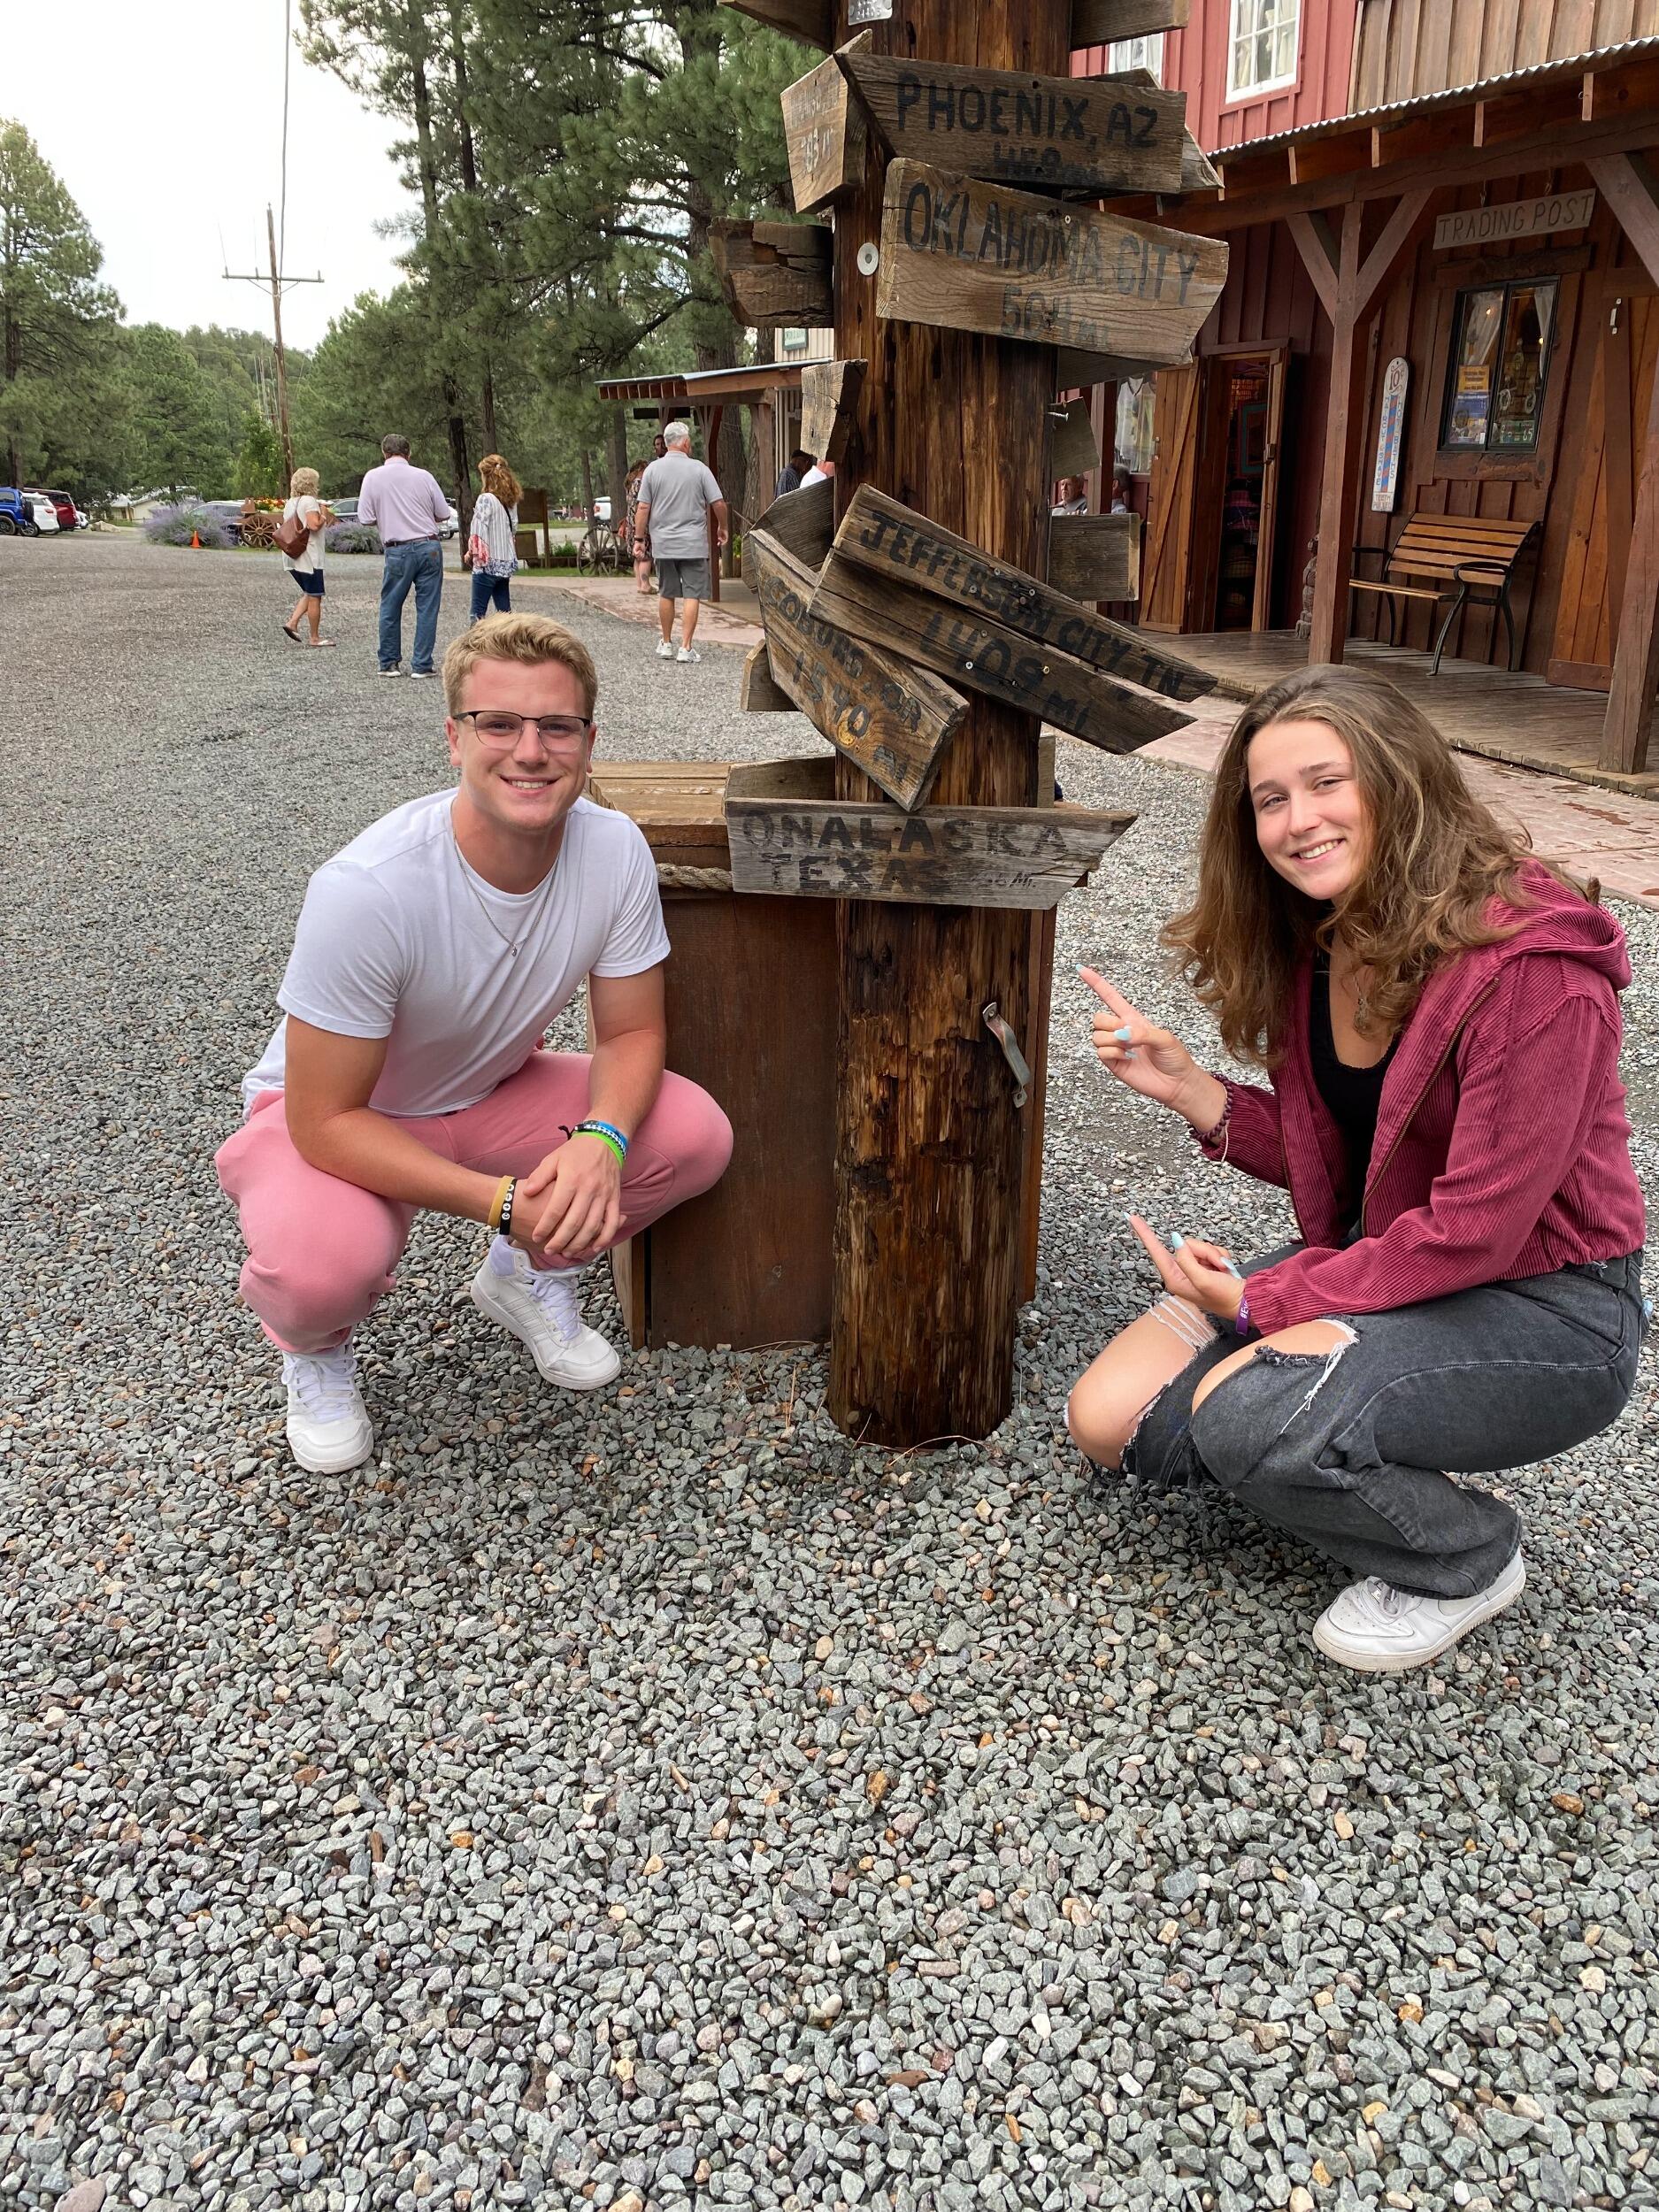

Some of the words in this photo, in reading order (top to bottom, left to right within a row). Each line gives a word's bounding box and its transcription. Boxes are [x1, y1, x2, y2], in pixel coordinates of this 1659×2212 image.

[896, 71, 1097, 153] PHOENIX,
[1107, 102, 1160, 149] AZ
[904, 182, 1104, 285] OKLAHOMA
[1116, 234, 1199, 306] CITY
[1437, 205, 1525, 242] TRADING
[1532, 193, 1593, 230] POST
[1376, 452, 1385, 486] SHAVE
[1390, 435, 1400, 479] BATHS
[861, 510, 1058, 637] JEFFERSON
[1059, 618, 1133, 668] CITY
[1140, 656, 1187, 697] TN
[793, 650, 872, 739] 1540
[741, 813, 1070, 857] ONALASKA
